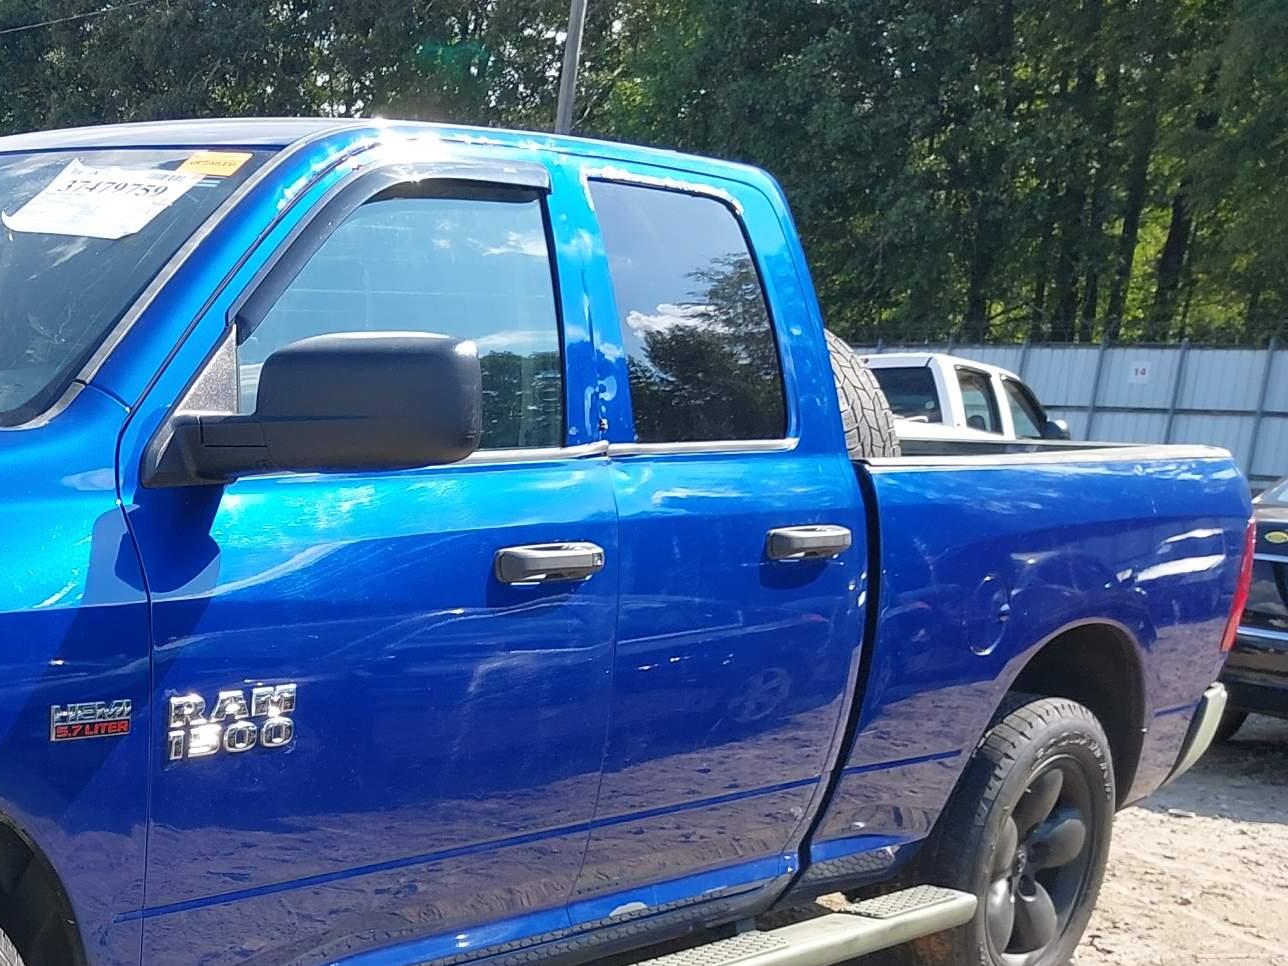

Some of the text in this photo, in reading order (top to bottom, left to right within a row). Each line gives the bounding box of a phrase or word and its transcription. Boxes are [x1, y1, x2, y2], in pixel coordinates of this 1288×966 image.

[57, 179, 169, 197] 37479759
[51, 699, 132, 723] HEMI
[169, 684, 297, 728] RAM
[56, 720, 129, 738] 5.7 LITER
[168, 716, 294, 760] 1500
